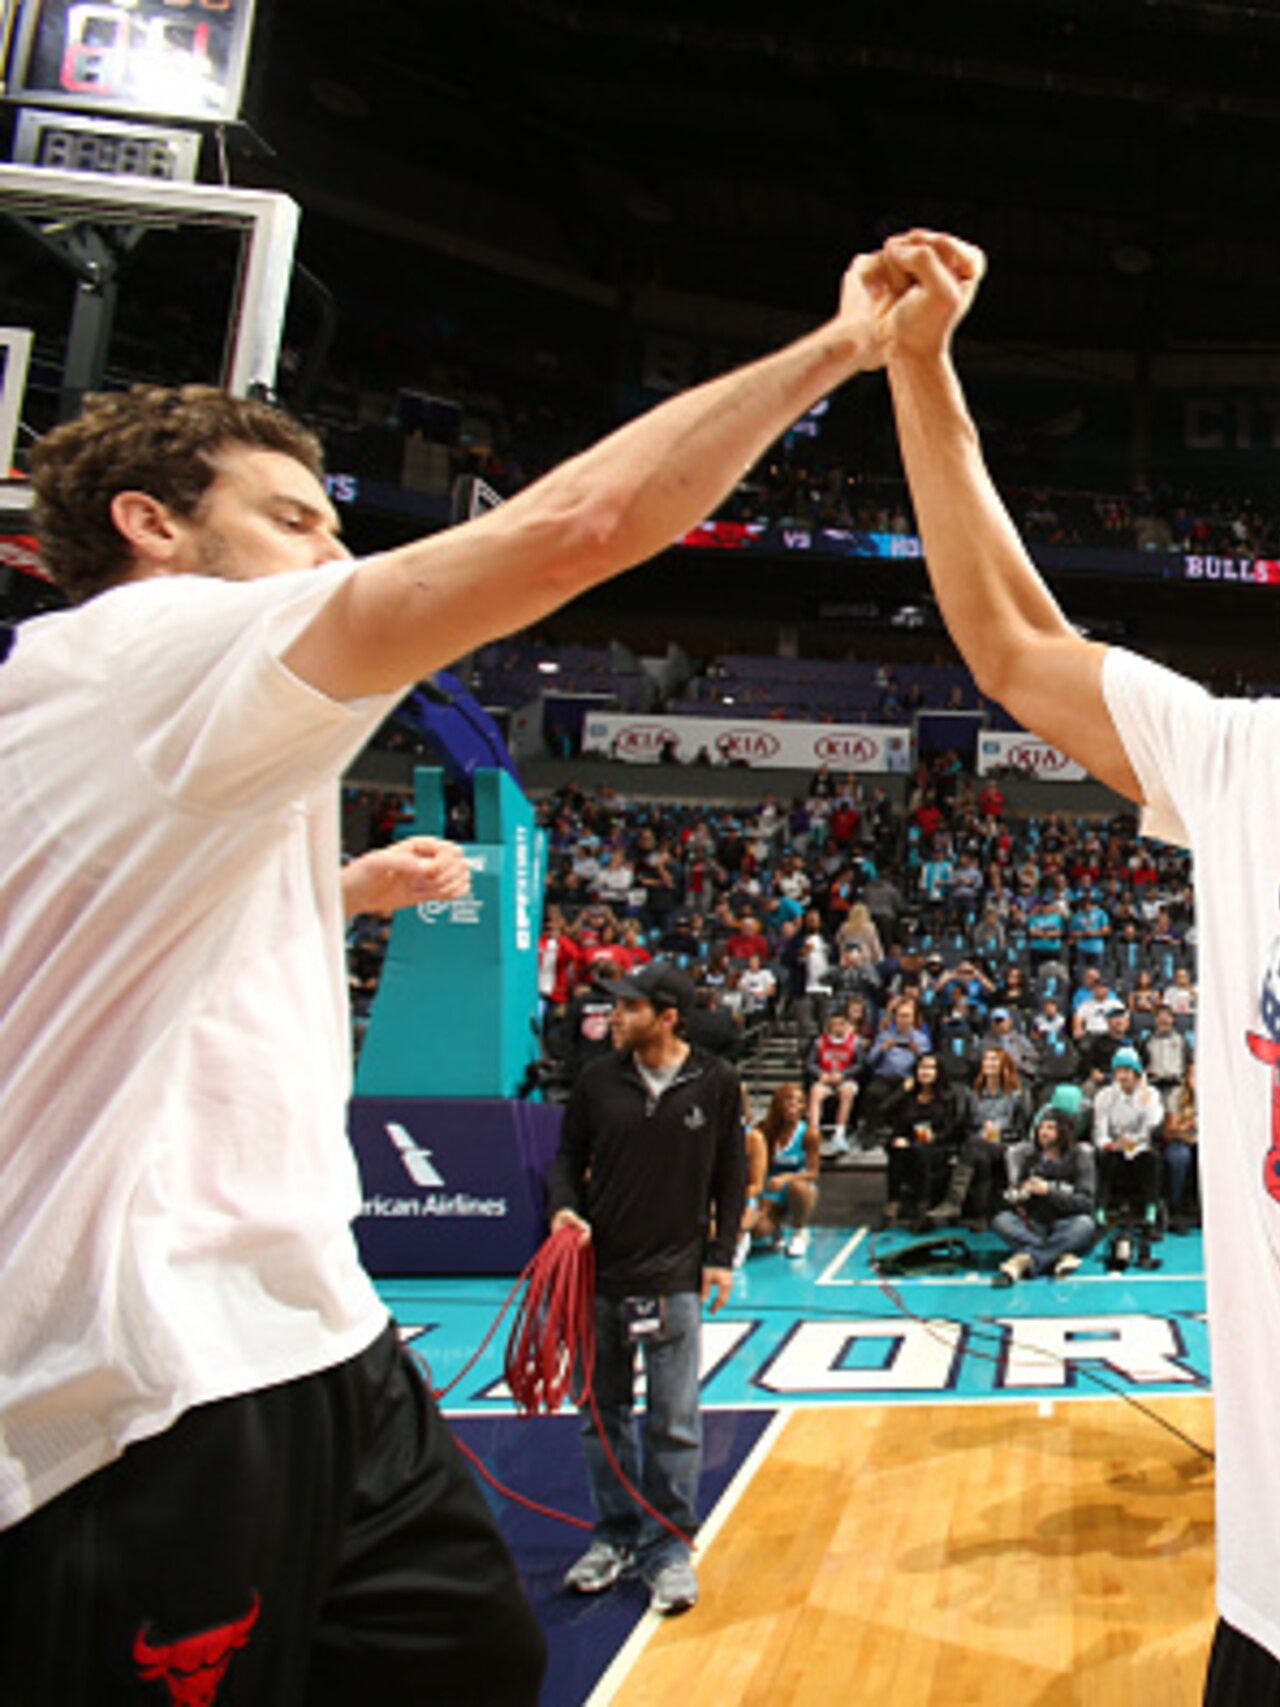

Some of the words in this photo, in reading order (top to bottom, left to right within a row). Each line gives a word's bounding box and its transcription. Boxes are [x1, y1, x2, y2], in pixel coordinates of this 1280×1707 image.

[1185, 555, 1269, 583] BULLS
[362, 1193, 419, 1217] rican
[422, 1193, 506, 1217] Airlines
